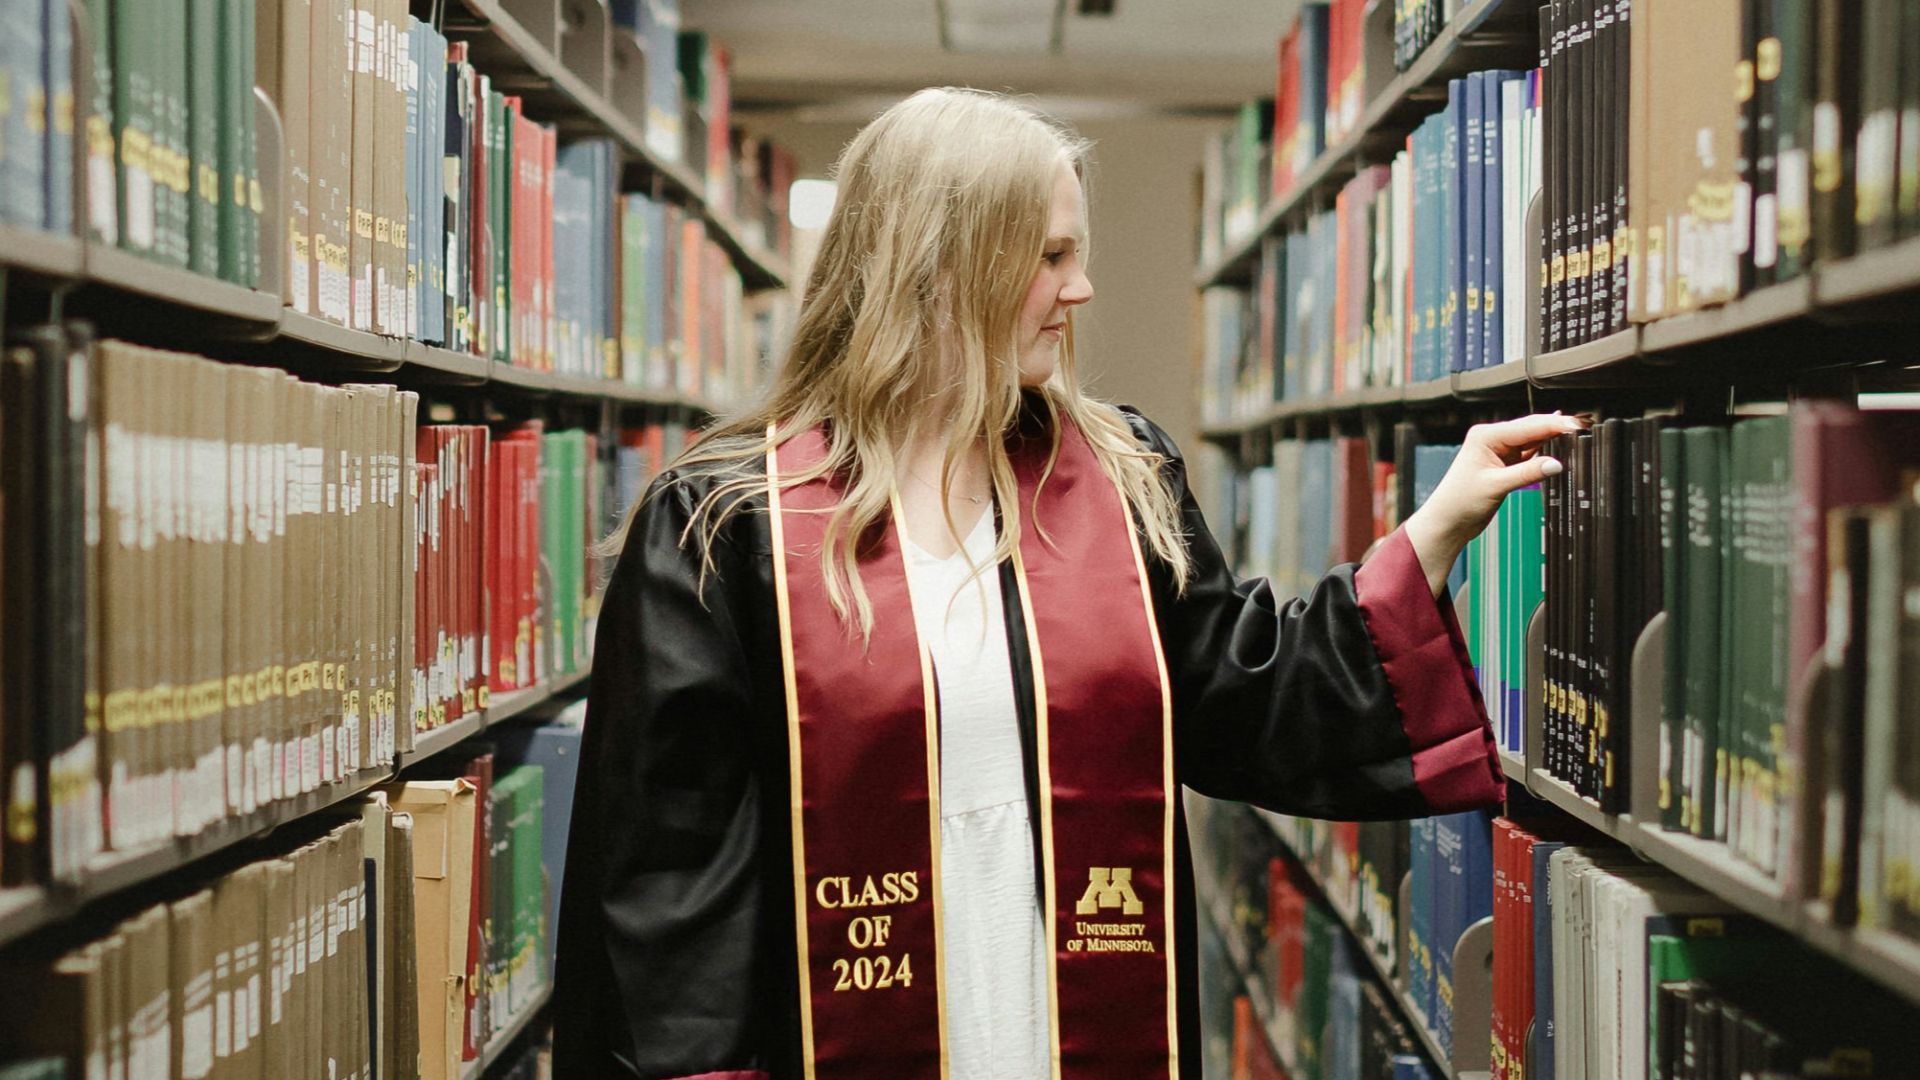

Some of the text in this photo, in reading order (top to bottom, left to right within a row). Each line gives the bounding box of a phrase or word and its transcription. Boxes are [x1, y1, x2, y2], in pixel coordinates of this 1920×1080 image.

[816, 871, 919, 909] CLASS
[1076, 867, 1143, 915] M
[848, 915, 892, 949] OF
[832, 953, 913, 992] 2024
